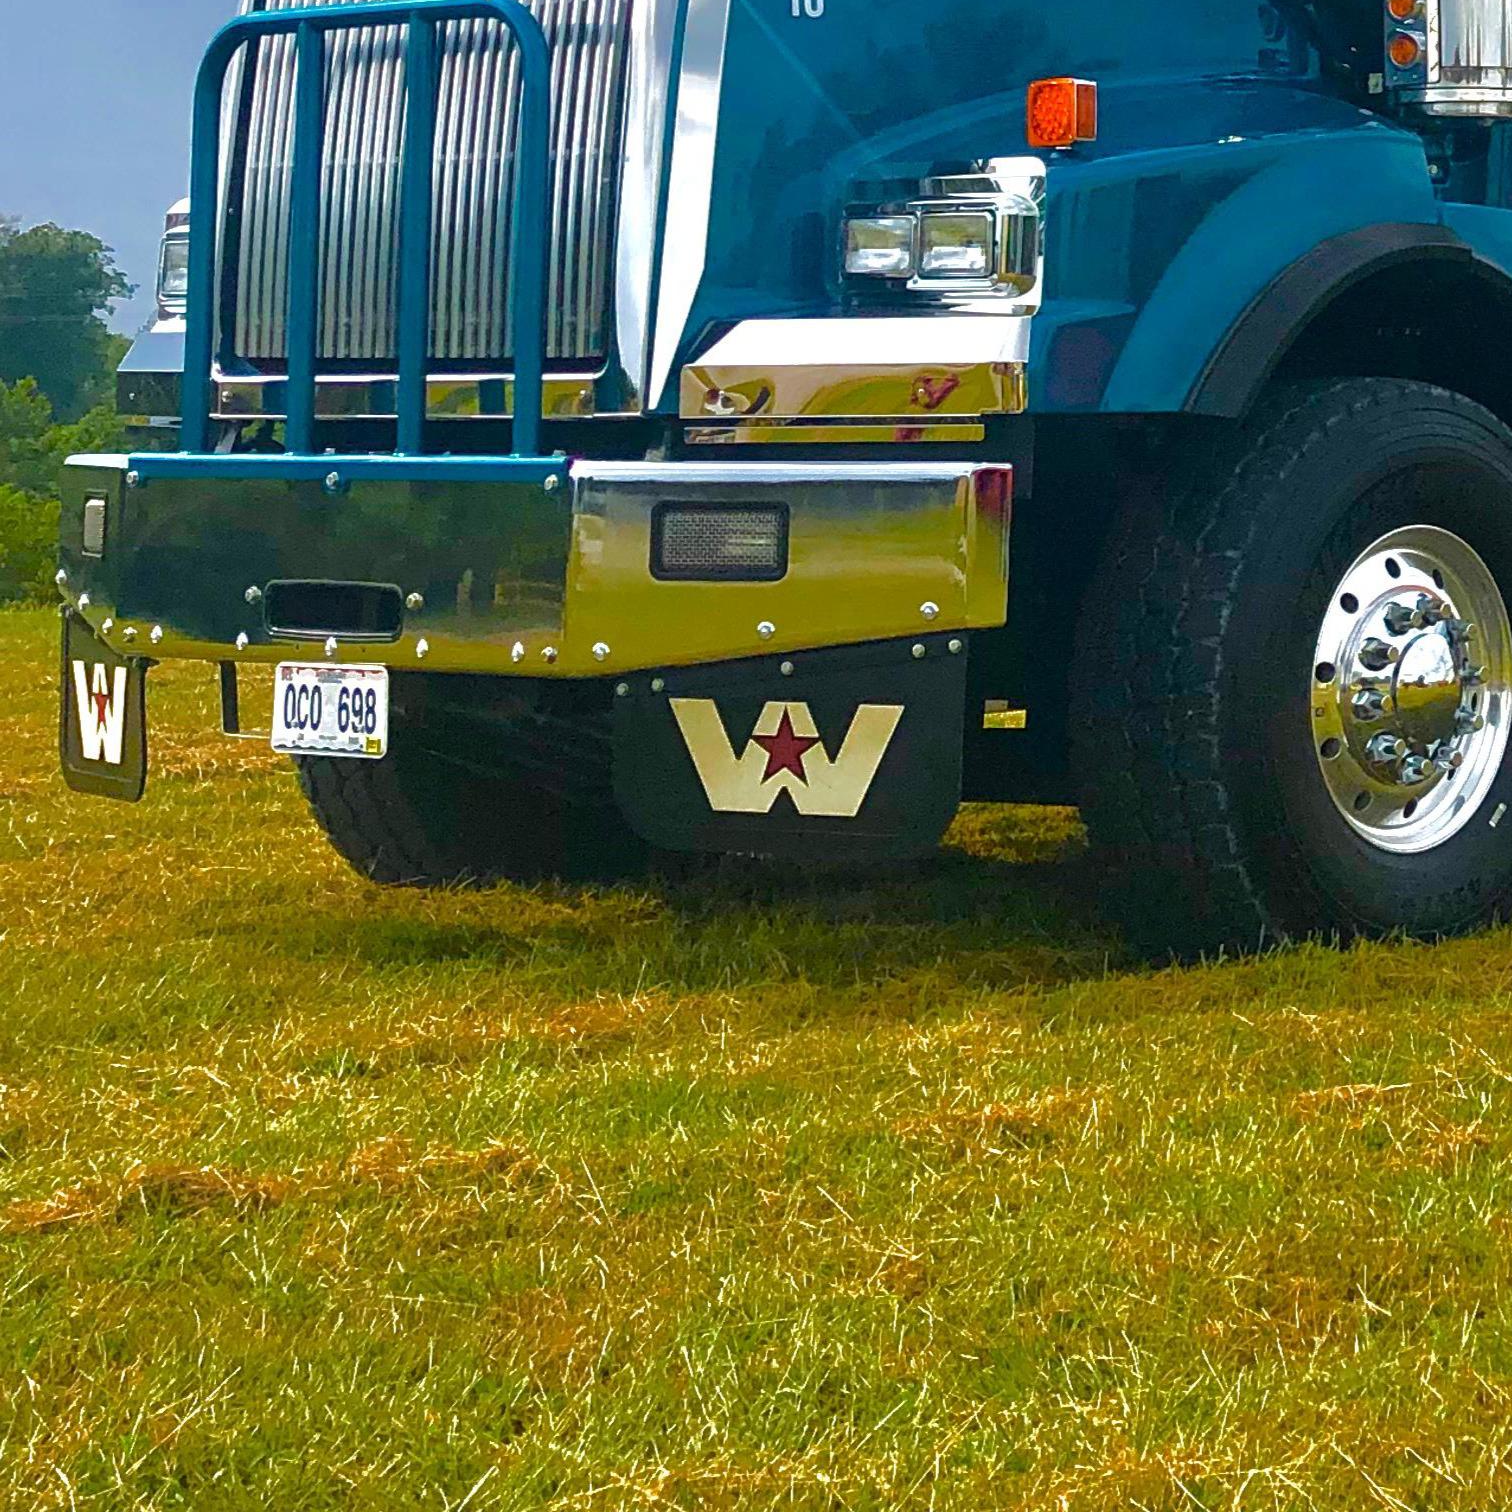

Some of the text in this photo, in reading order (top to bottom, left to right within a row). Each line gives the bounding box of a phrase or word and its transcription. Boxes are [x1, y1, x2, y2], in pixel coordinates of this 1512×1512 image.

[72, 659, 128, 765] W
[337, 686, 377, 735] 698
[668, 697, 906, 818] W
